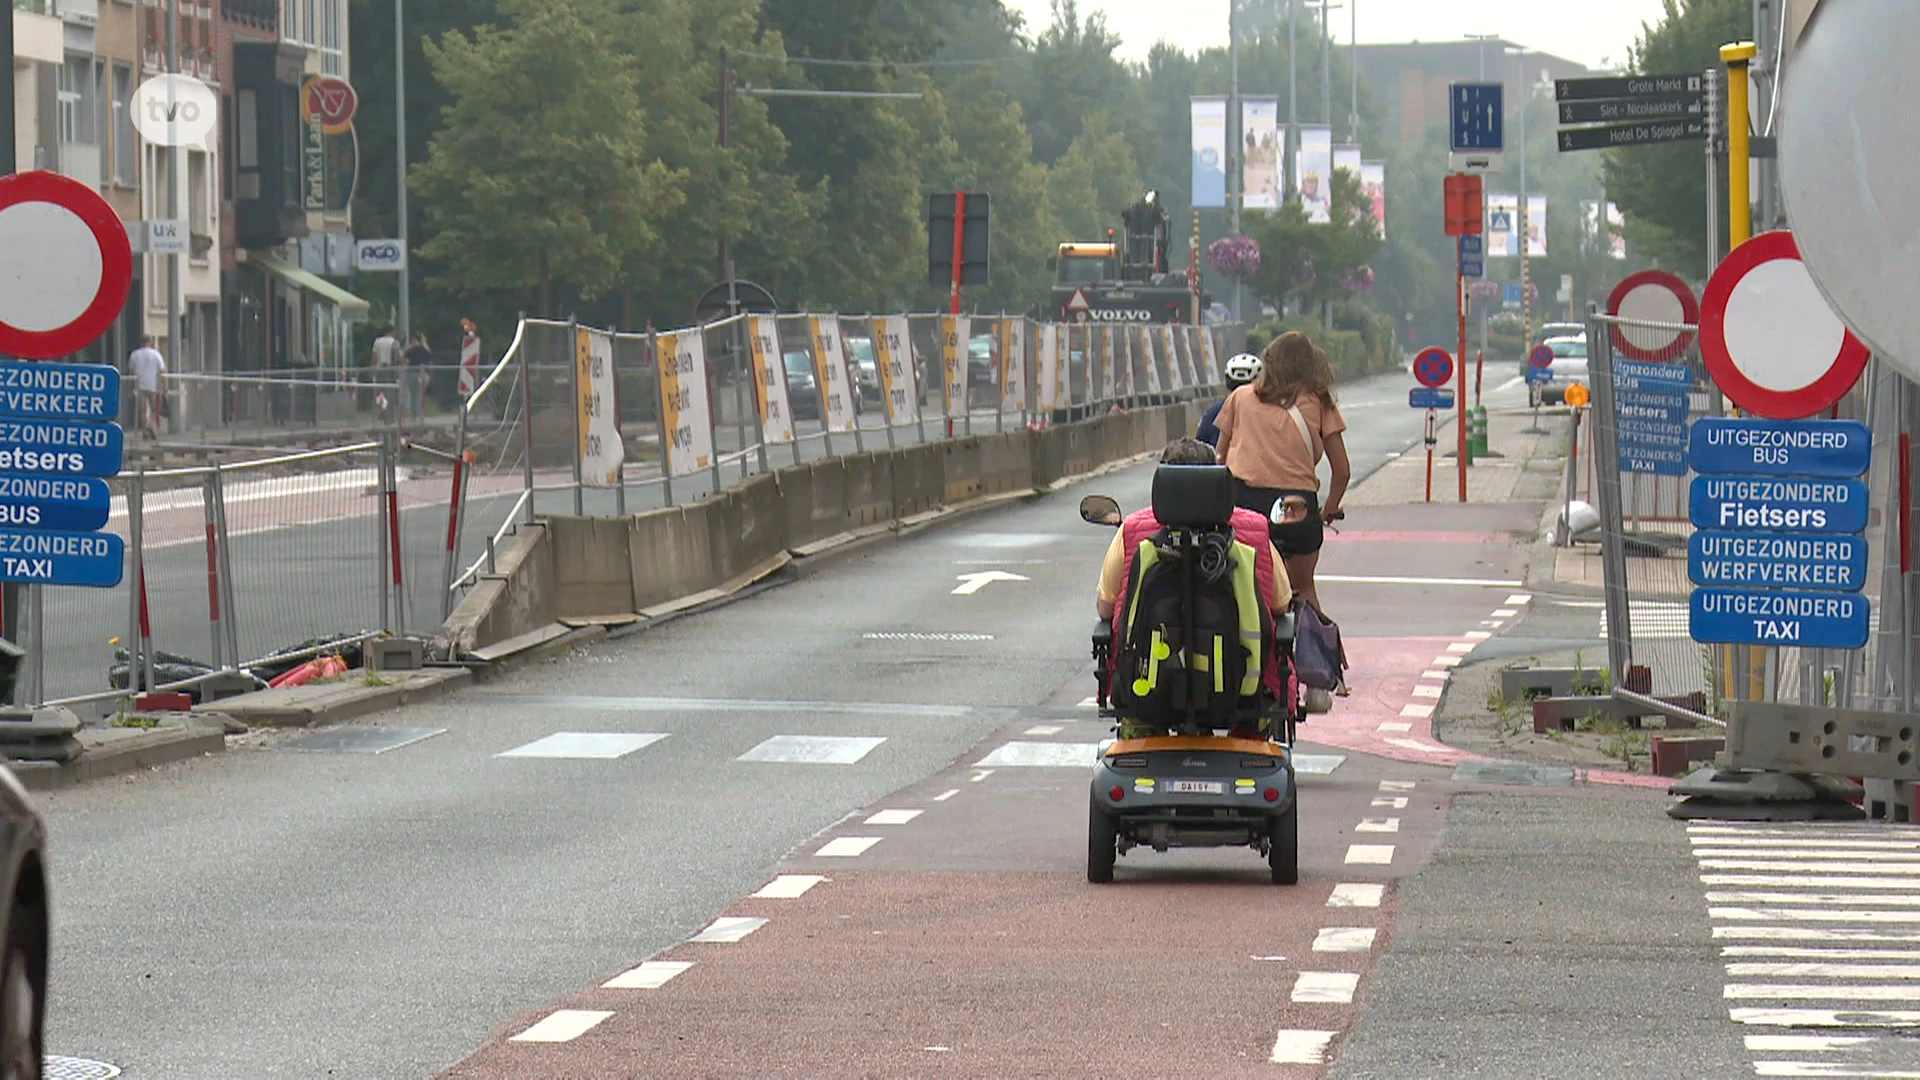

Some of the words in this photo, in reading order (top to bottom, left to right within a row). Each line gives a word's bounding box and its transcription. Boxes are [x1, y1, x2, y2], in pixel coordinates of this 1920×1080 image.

[1628, 80, 1653, 93] Grote
[1656, 79, 1681, 91] Markt
[1600, 103, 1618, 117] Sint
[1627, 100, 1682, 114] Nicolaaskerk
[1610, 128, 1634, 142] Hotel
[1636, 127, 1648, 139] De
[1651, 122, 1684, 139] Spiegel
[1089, 309, 1151, 320] VOLVO
[1707, 429, 1848, 449] UITGEZONDERD
[1631, 460, 1656, 471] TAXI
[1753, 448, 1789, 465] BUS
[1707, 481, 1849, 503] UITGEZONDERD
[0, 505, 40, 524] BUS
[1720, 502, 1827, 527] Fietsers
[1702, 537, 1852, 561] UITGEZONDERD
[3, 558, 53, 578] TAXI
[1701, 561, 1851, 585] WERFVERKEER
[1702, 594, 1853, 619] UITGEZONDERD
[1753, 620, 1800, 641] TAXI
